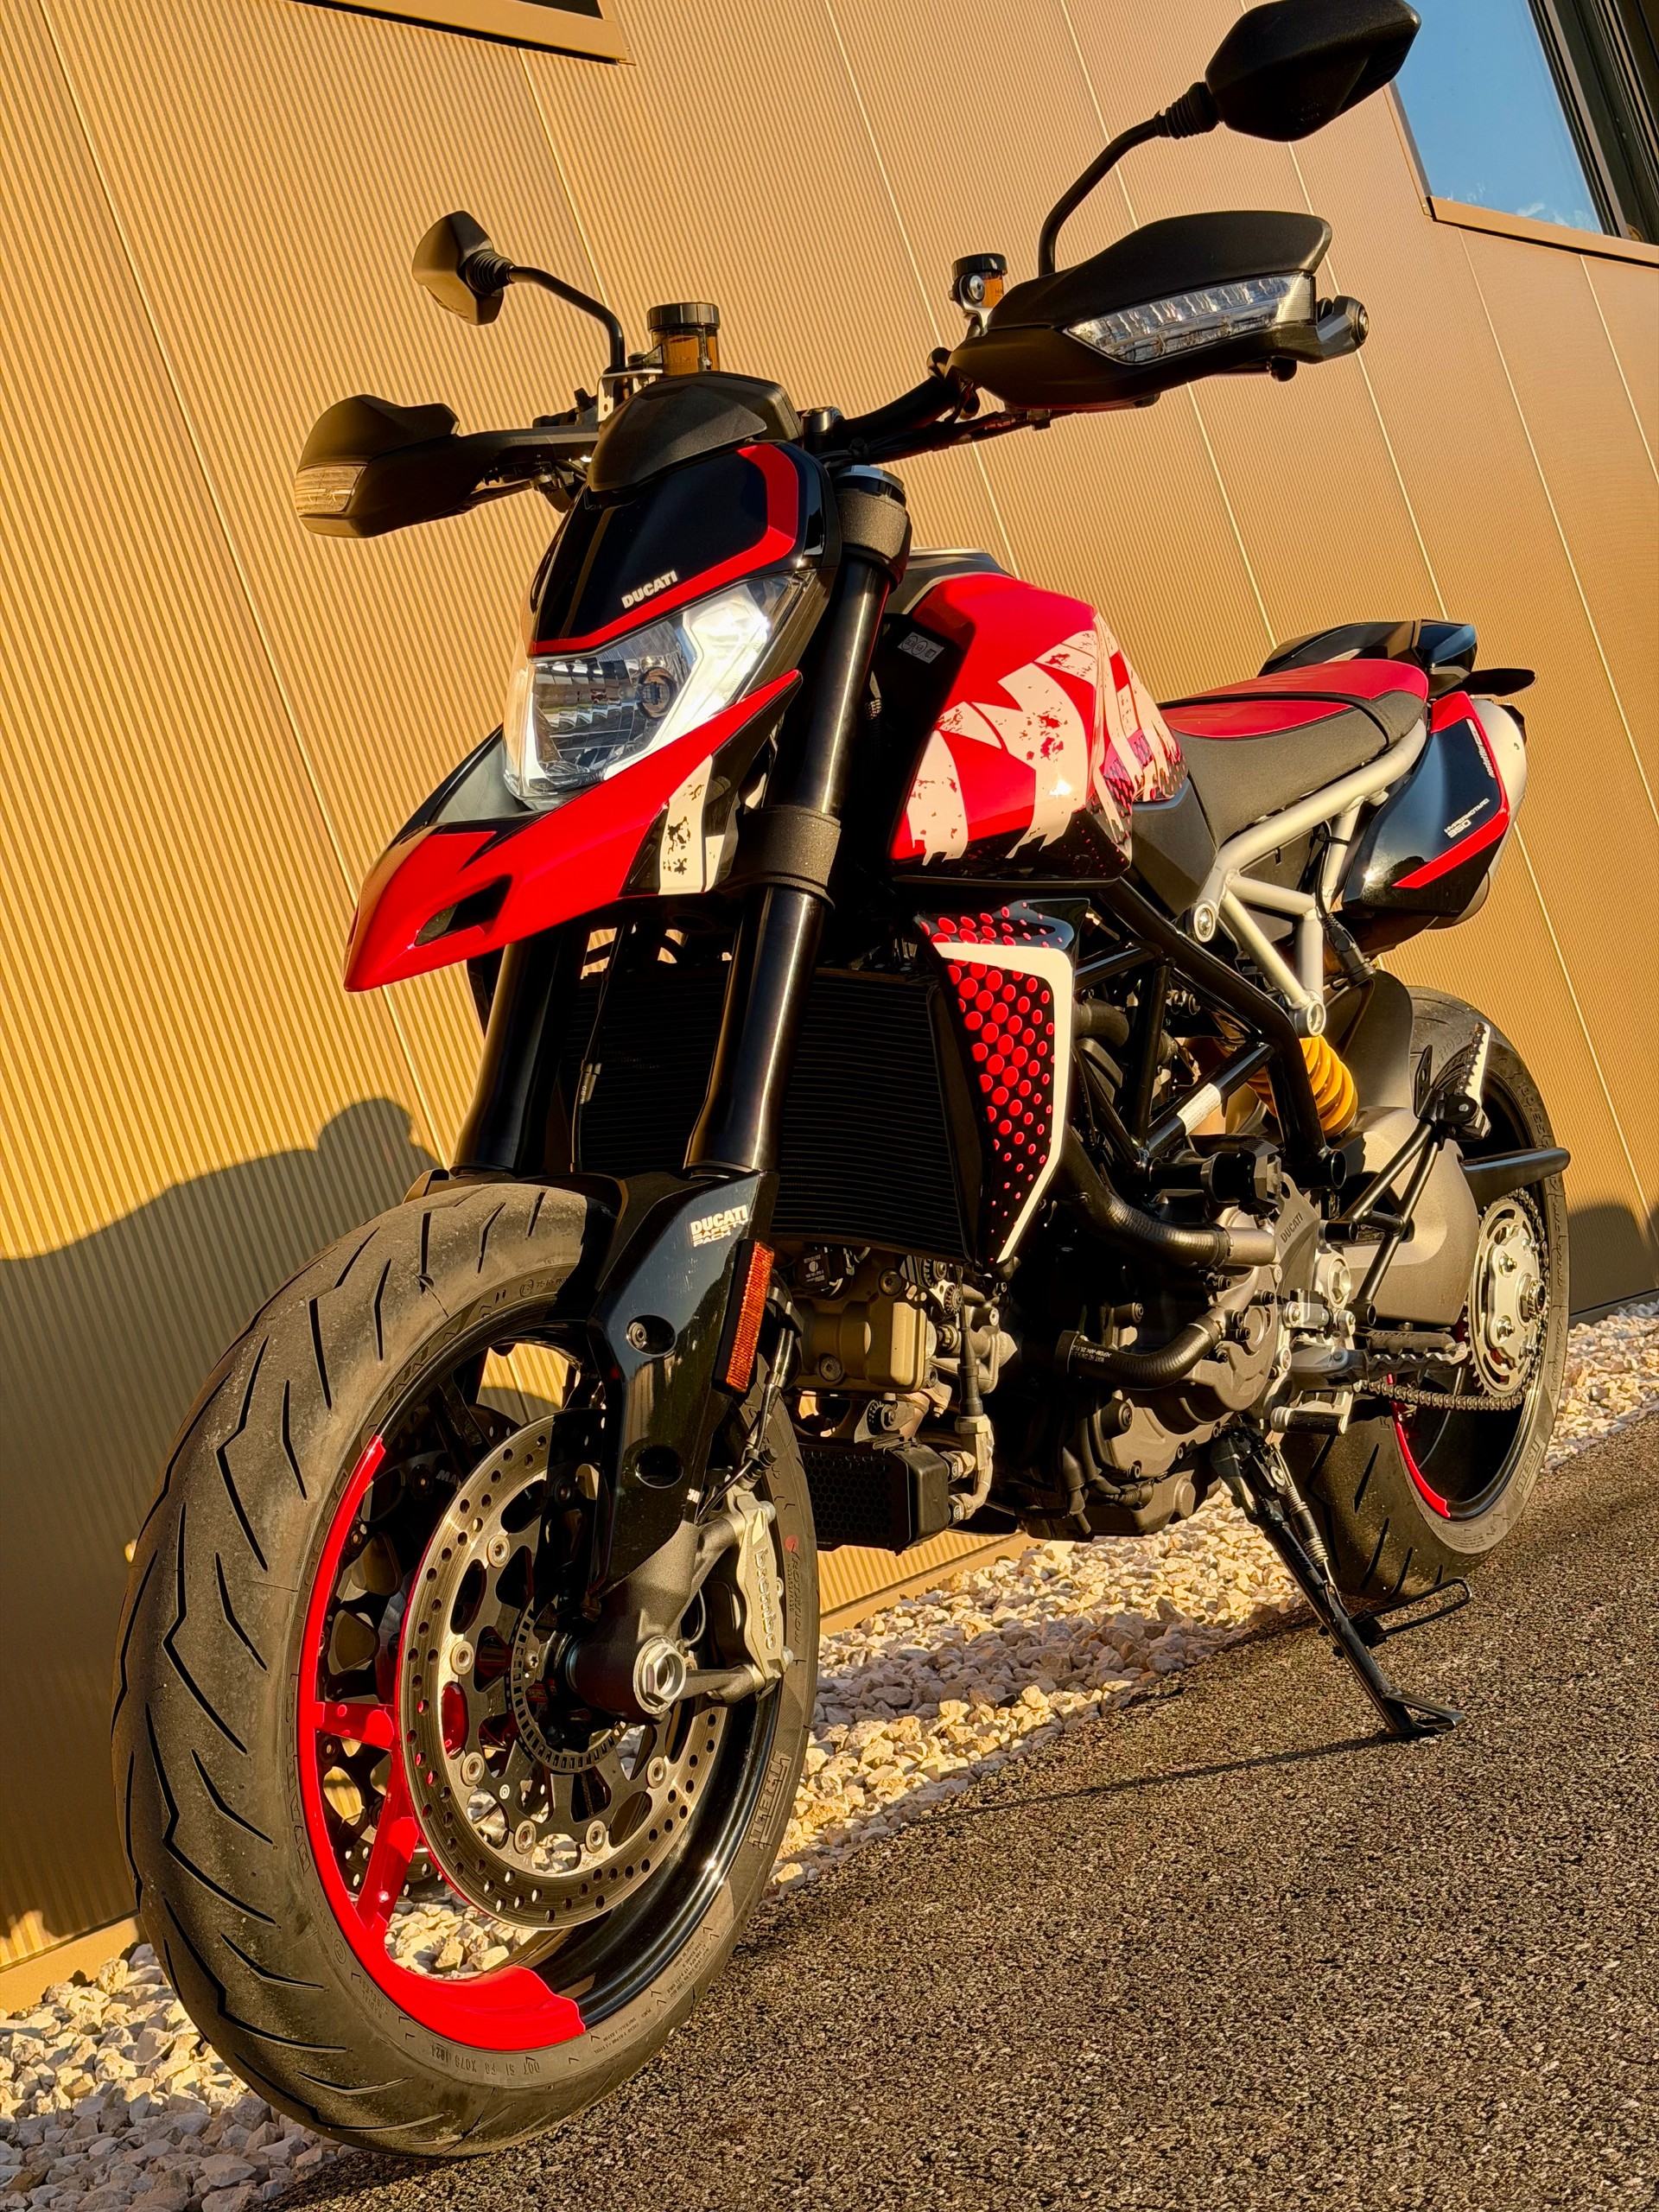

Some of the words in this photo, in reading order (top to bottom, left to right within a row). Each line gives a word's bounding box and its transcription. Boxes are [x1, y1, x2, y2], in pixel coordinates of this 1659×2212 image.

[621, 570, 678, 609] DUCATI
[1447, 819, 1472, 839] 950
[690, 1205, 748, 1236] DUCATI
[1280, 1212, 1304, 1243] DUCATI
[693, 1230, 732, 1248] PACK
[753, 1547, 776, 1650] brembo
[791, 1557, 801, 1644] ROTATION
